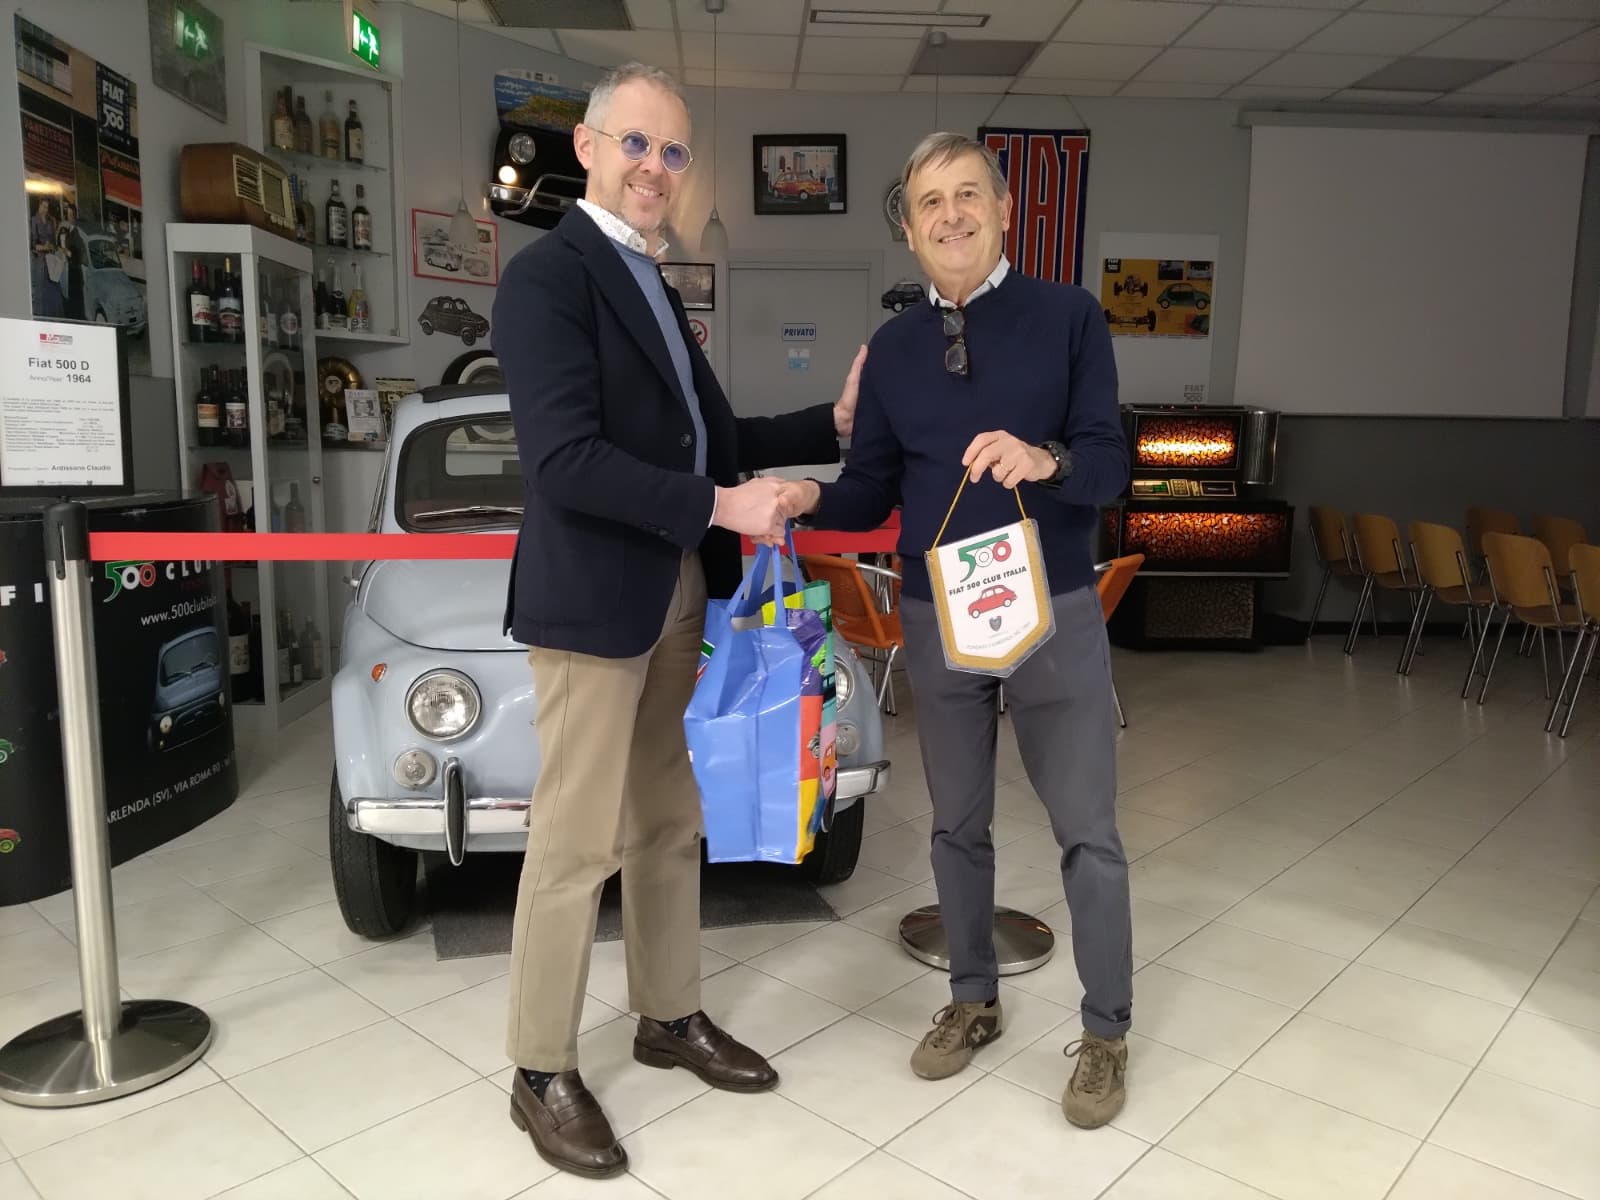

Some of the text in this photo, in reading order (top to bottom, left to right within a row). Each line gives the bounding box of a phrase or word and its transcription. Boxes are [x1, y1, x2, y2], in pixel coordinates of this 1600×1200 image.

[102, 79, 125, 105] FIAT
[102, 103, 125, 131] 500
[985, 133, 1089, 285] IAT
[784, 328, 815, 337] PRIVATO
[28, 357, 90, 371] Fiat 500 D
[66, 374, 92, 383] 1964
[958, 532, 1012, 583] 500
[103, 560, 157, 602] 500
[948, 565, 1028, 597] FIAT 500 CLUB ITALIA
[174, 780, 189, 794] VIA
[189, 767, 212, 787] ROMA
